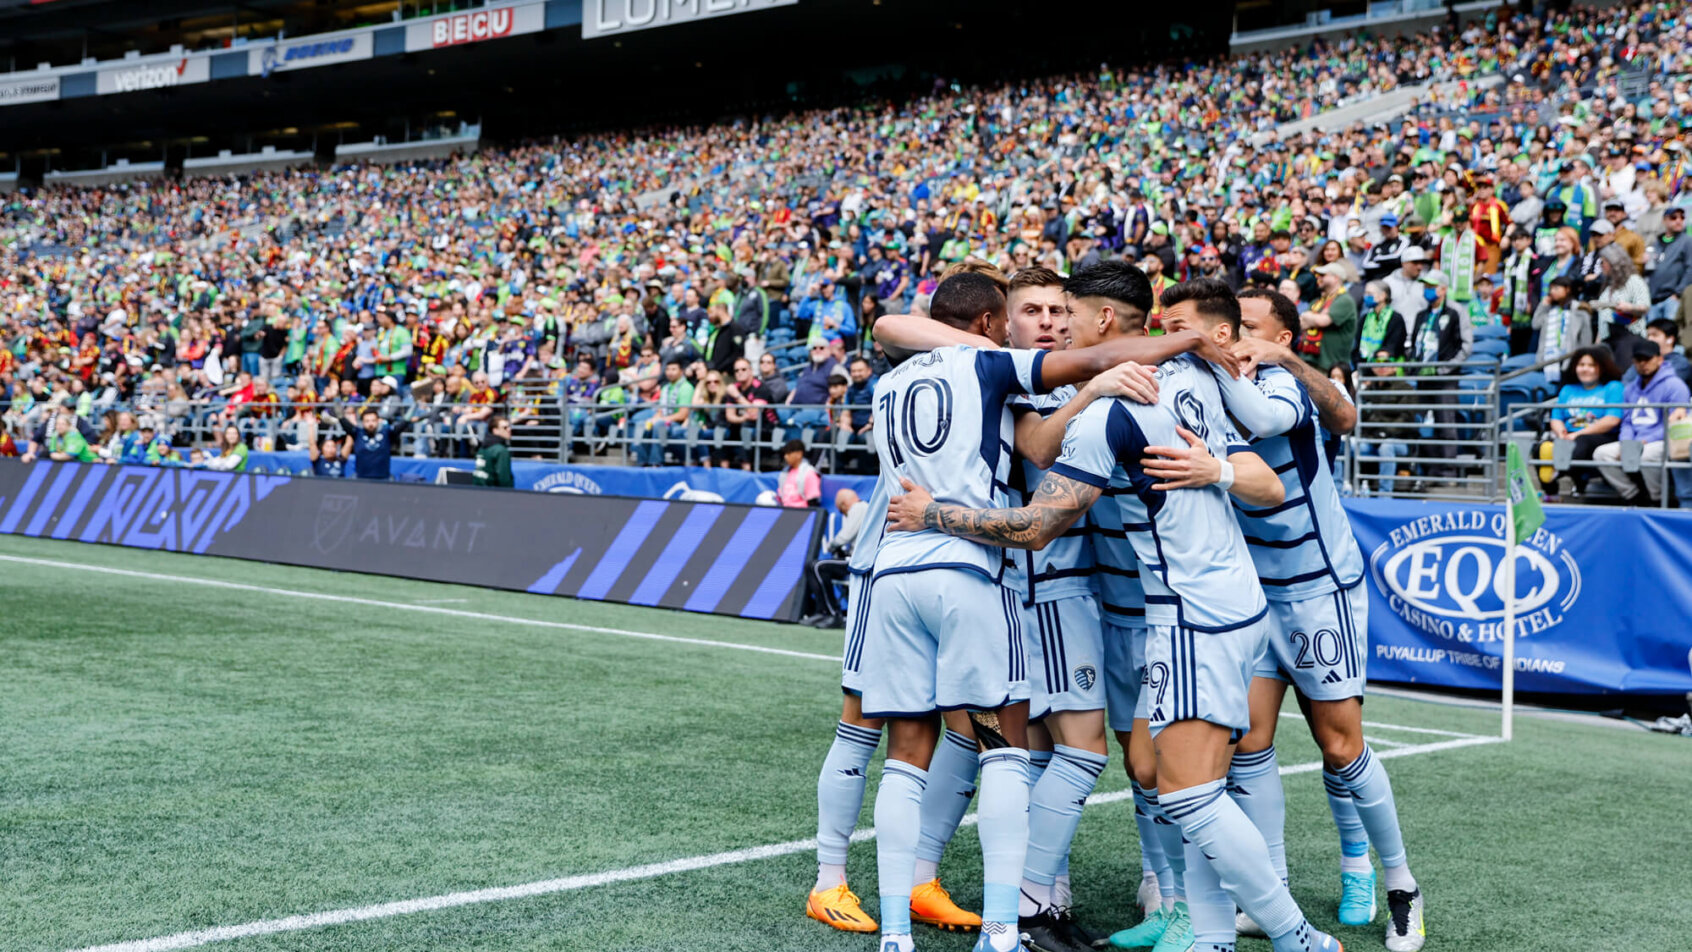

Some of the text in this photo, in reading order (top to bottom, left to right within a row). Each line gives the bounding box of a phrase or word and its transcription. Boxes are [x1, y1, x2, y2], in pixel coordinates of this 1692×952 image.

[434, 9, 510, 44] BECU
[595, 0, 776, 30] LUM
[284, 38, 355, 61] BOEING
[115, 64, 178, 91] verizon
[879, 377, 953, 468] 10
[359, 515, 486, 553] AVANT
[1389, 511, 1563, 555] EMERALD QEN
[1406, 546, 1539, 620] EQC
[1389, 594, 1454, 639] CASINO
[1457, 622, 1473, 642] &
[1290, 628, 1343, 669] 20
[1376, 644, 1566, 673] PUYALLUP TRIBE OF DIANS
[1150, 661, 1170, 704] 9
